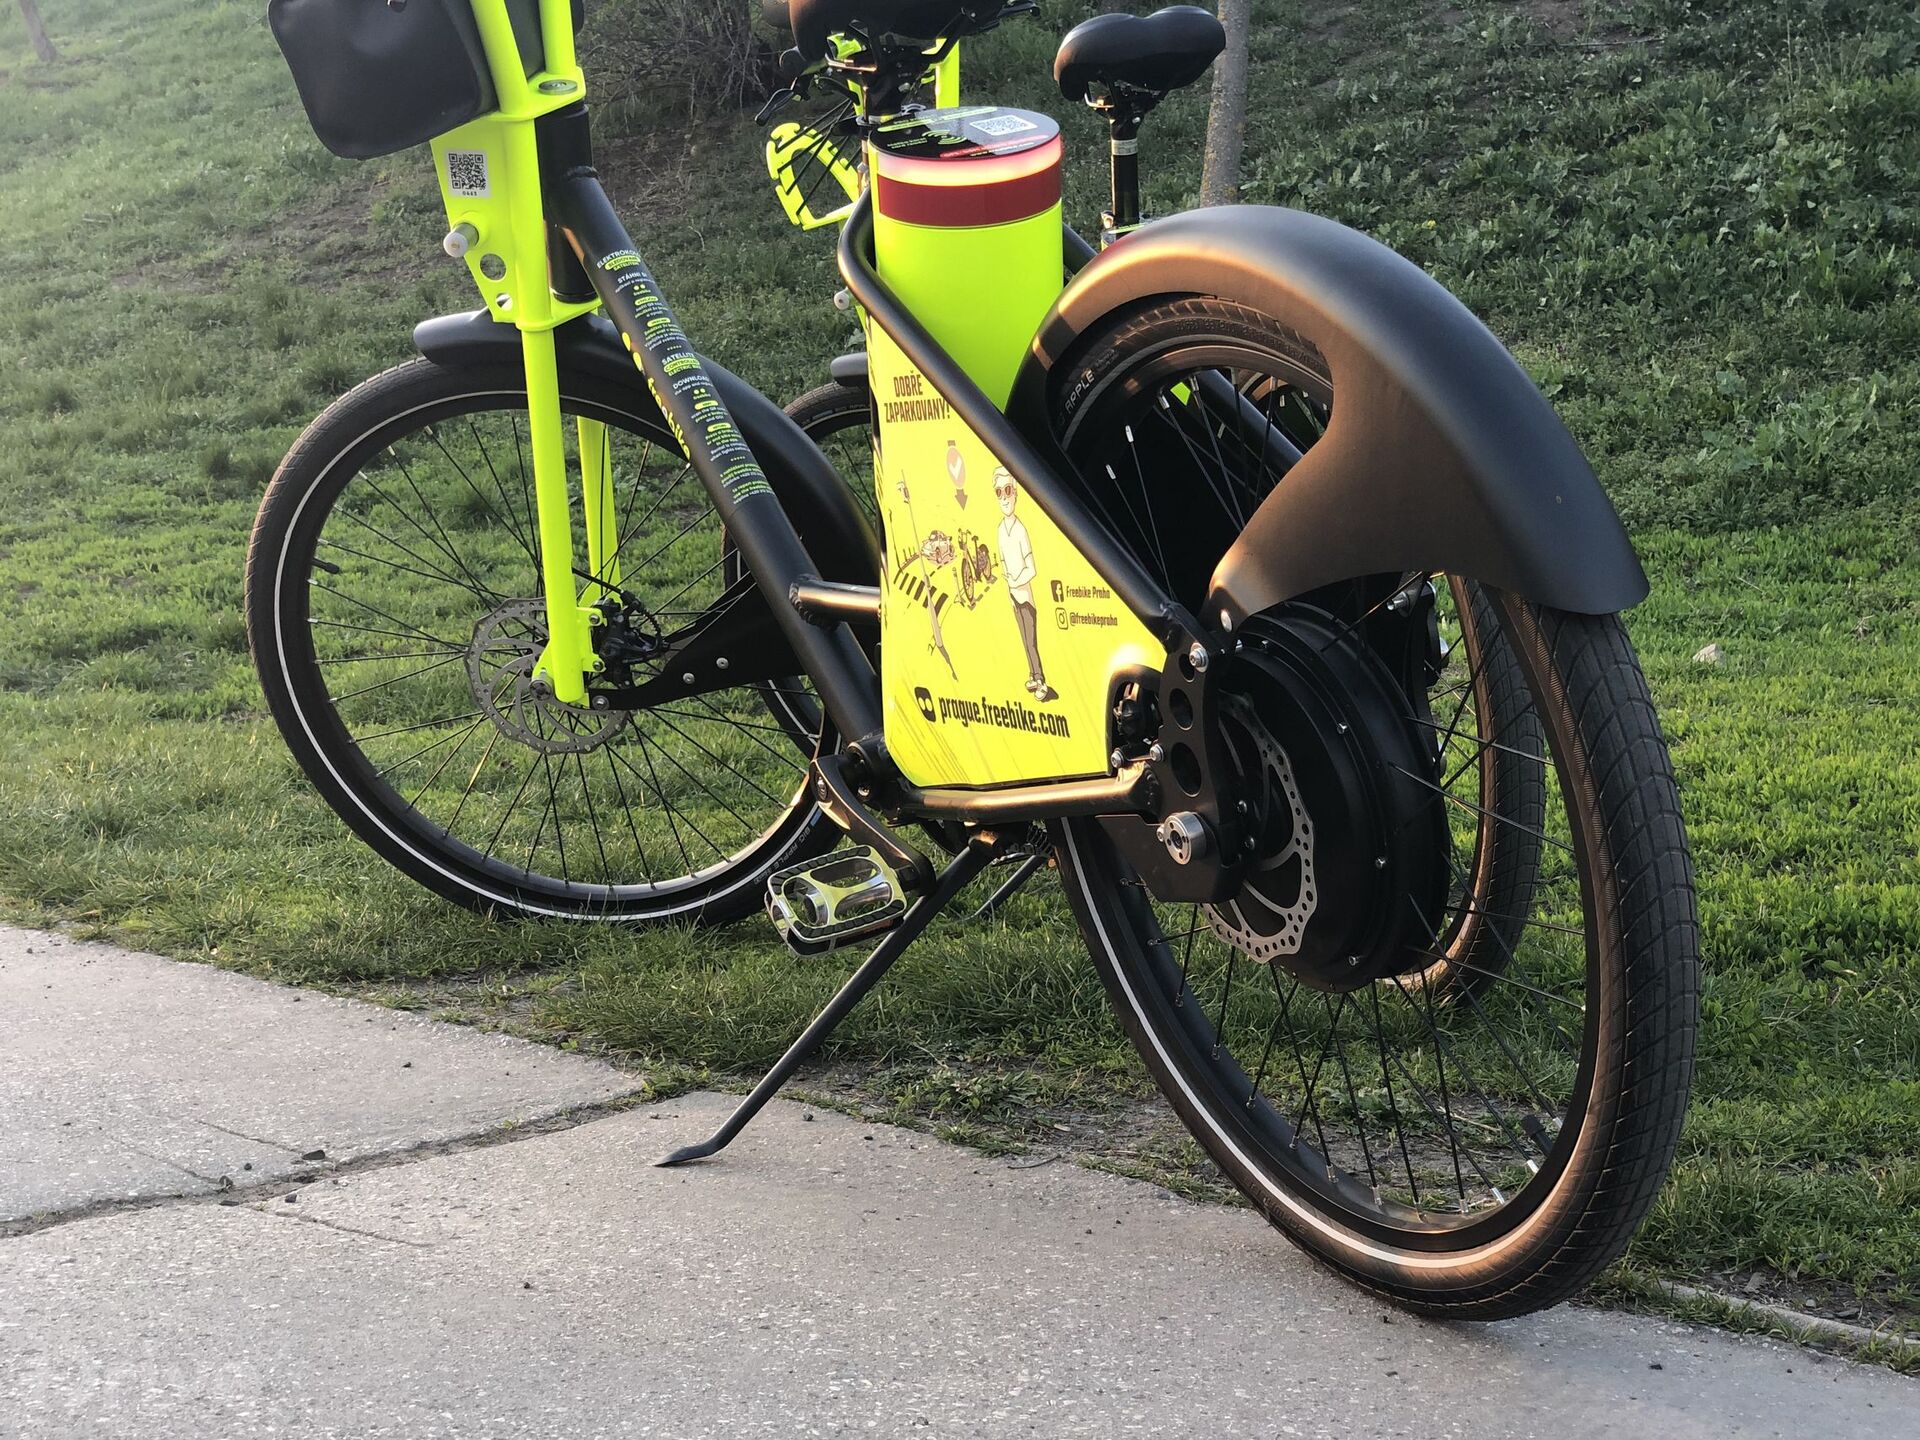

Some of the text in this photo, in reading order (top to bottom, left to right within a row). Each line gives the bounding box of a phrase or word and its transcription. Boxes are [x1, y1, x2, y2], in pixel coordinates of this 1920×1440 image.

[893, 370, 923, 397] DOBŘE
[1064, 369, 1095, 414] APPLE
[1066, 585, 1111, 599] Freebike Praha
[1069, 611, 1118, 628] @freebikepraha
[938, 696, 1070, 738] prague.freebike.com
